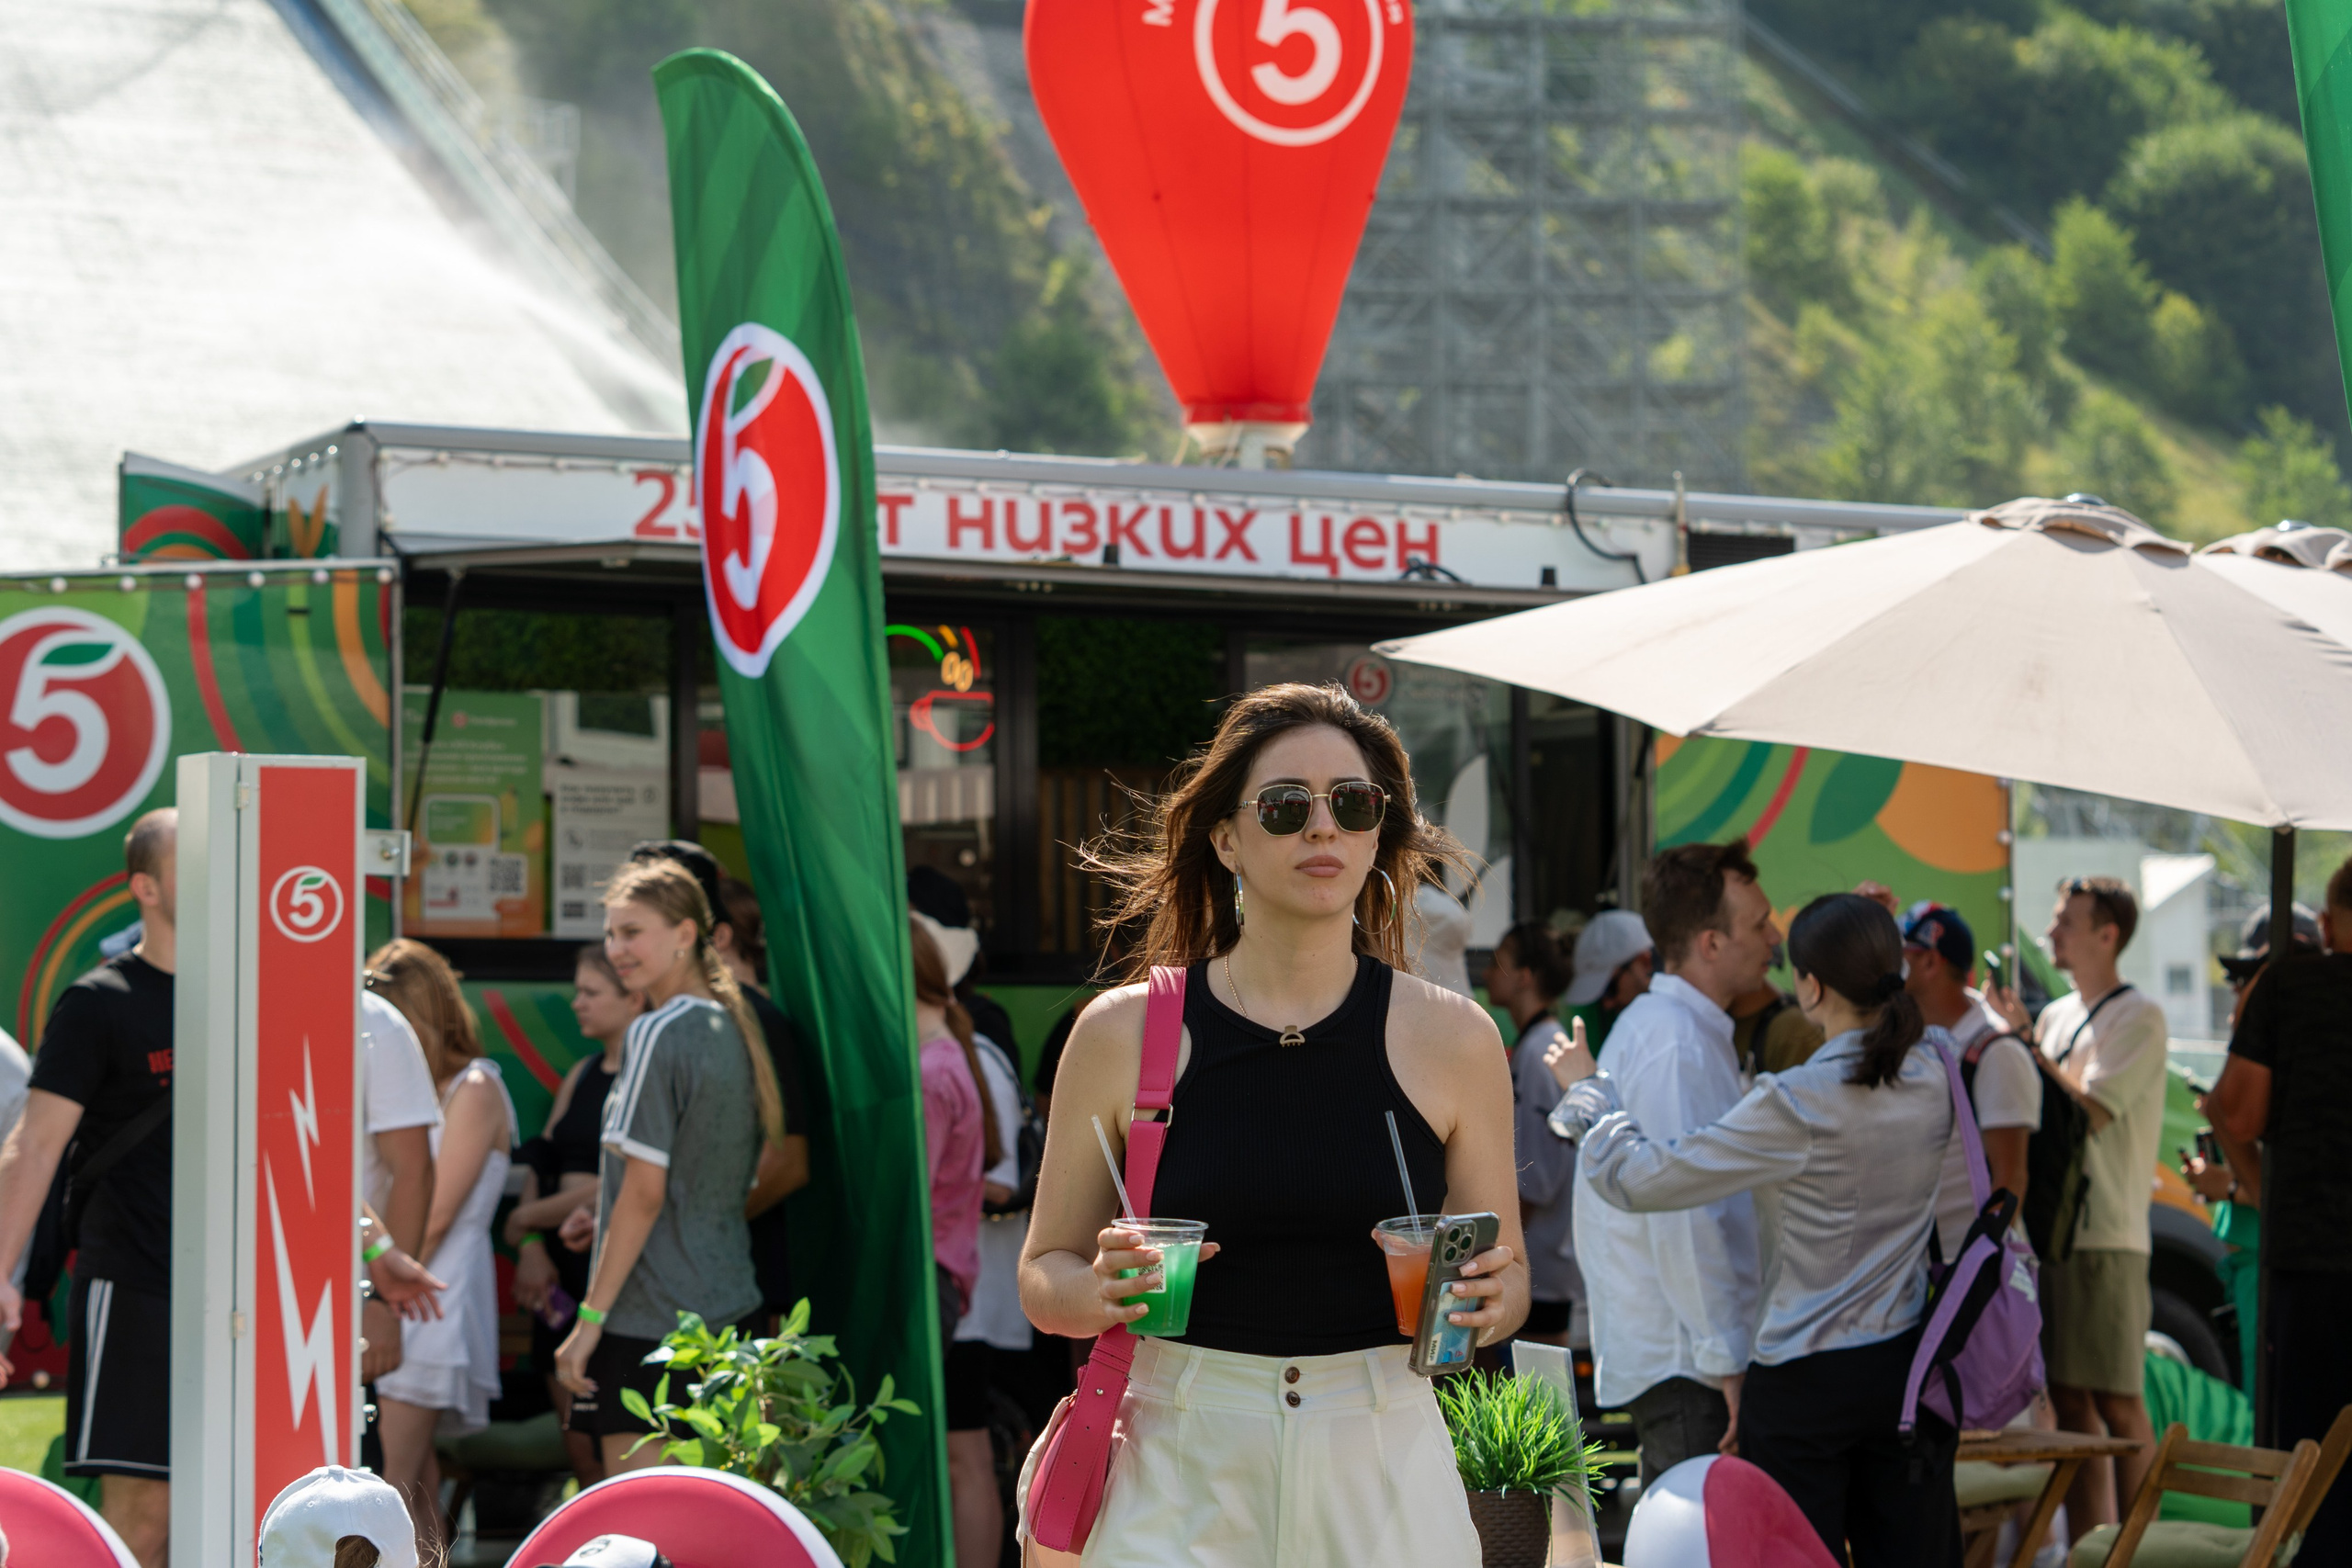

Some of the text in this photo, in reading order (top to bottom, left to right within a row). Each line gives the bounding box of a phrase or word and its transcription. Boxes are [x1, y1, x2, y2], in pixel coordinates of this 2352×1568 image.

[1250, 0, 1343, 107] 5
[947, 496, 1260, 563] низких
[1289, 513, 1440, 580] цен
[5, 630, 126, 795] 5
[288, 870, 327, 930] 5
